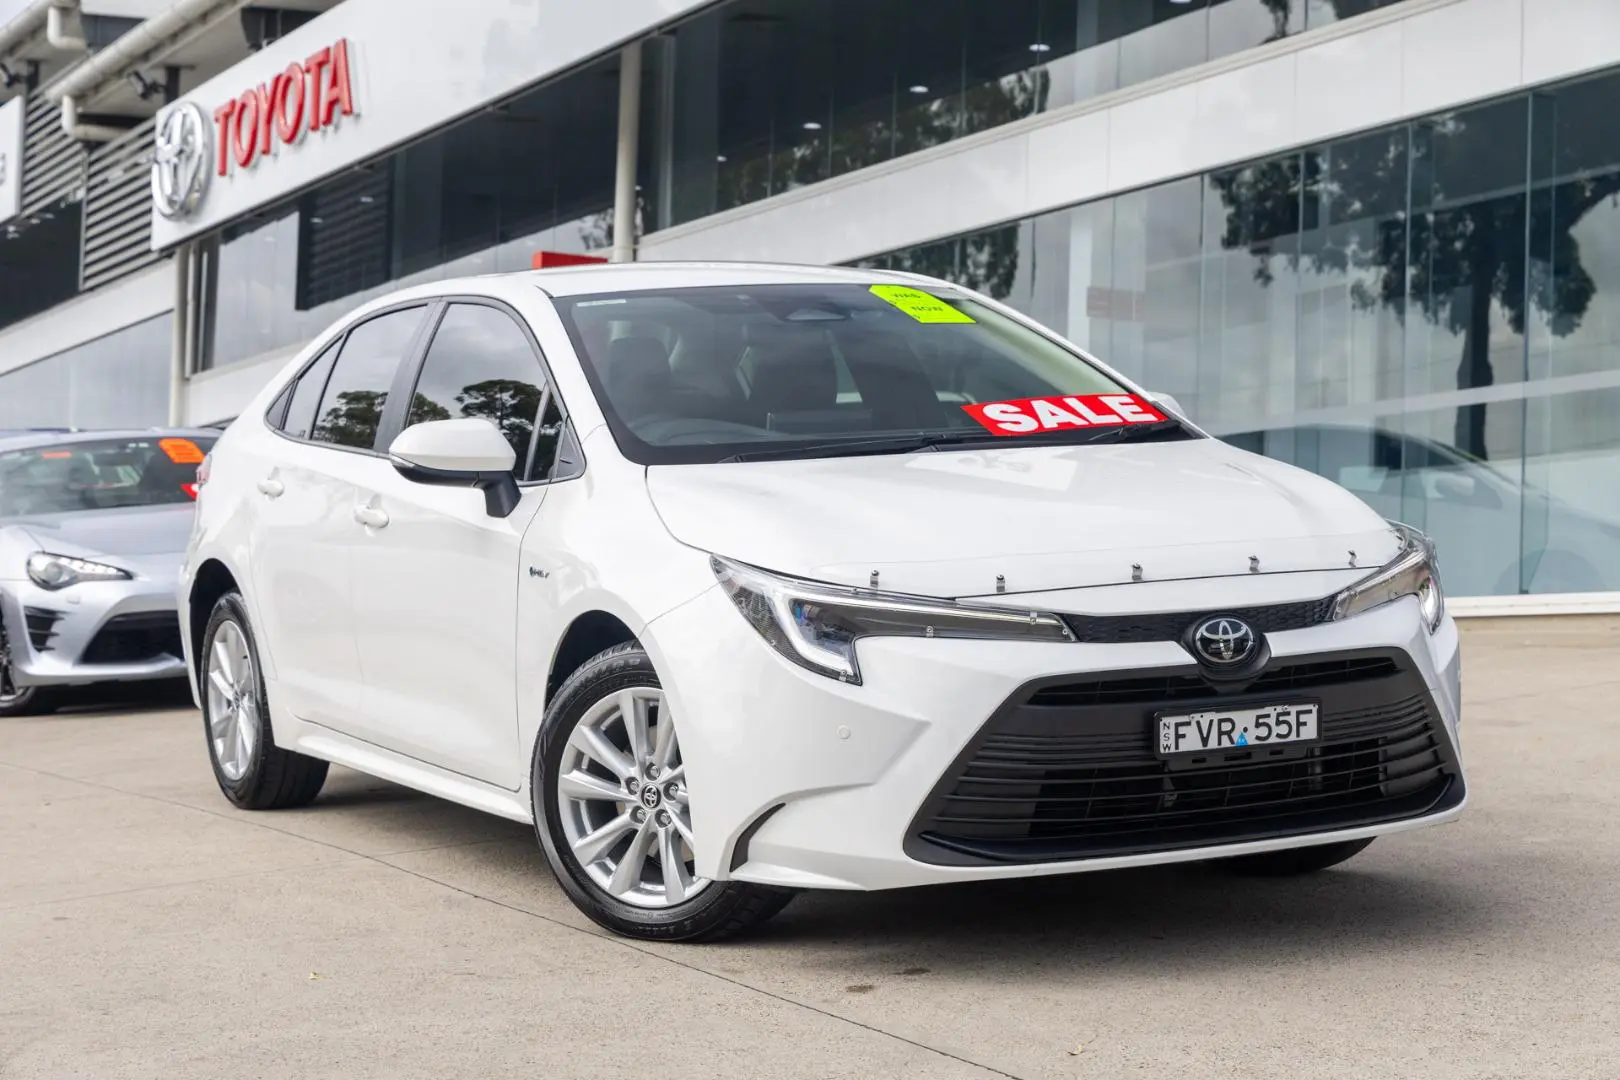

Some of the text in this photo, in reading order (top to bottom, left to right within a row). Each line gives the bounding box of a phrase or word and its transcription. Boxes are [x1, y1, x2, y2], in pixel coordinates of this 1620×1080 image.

[214, 38, 353, 176] TOYOTA
[982, 396, 1158, 432] SALE
[1162, 722, 1172, 752] NSW
[1174, 709, 1313, 750] FVR 55F
